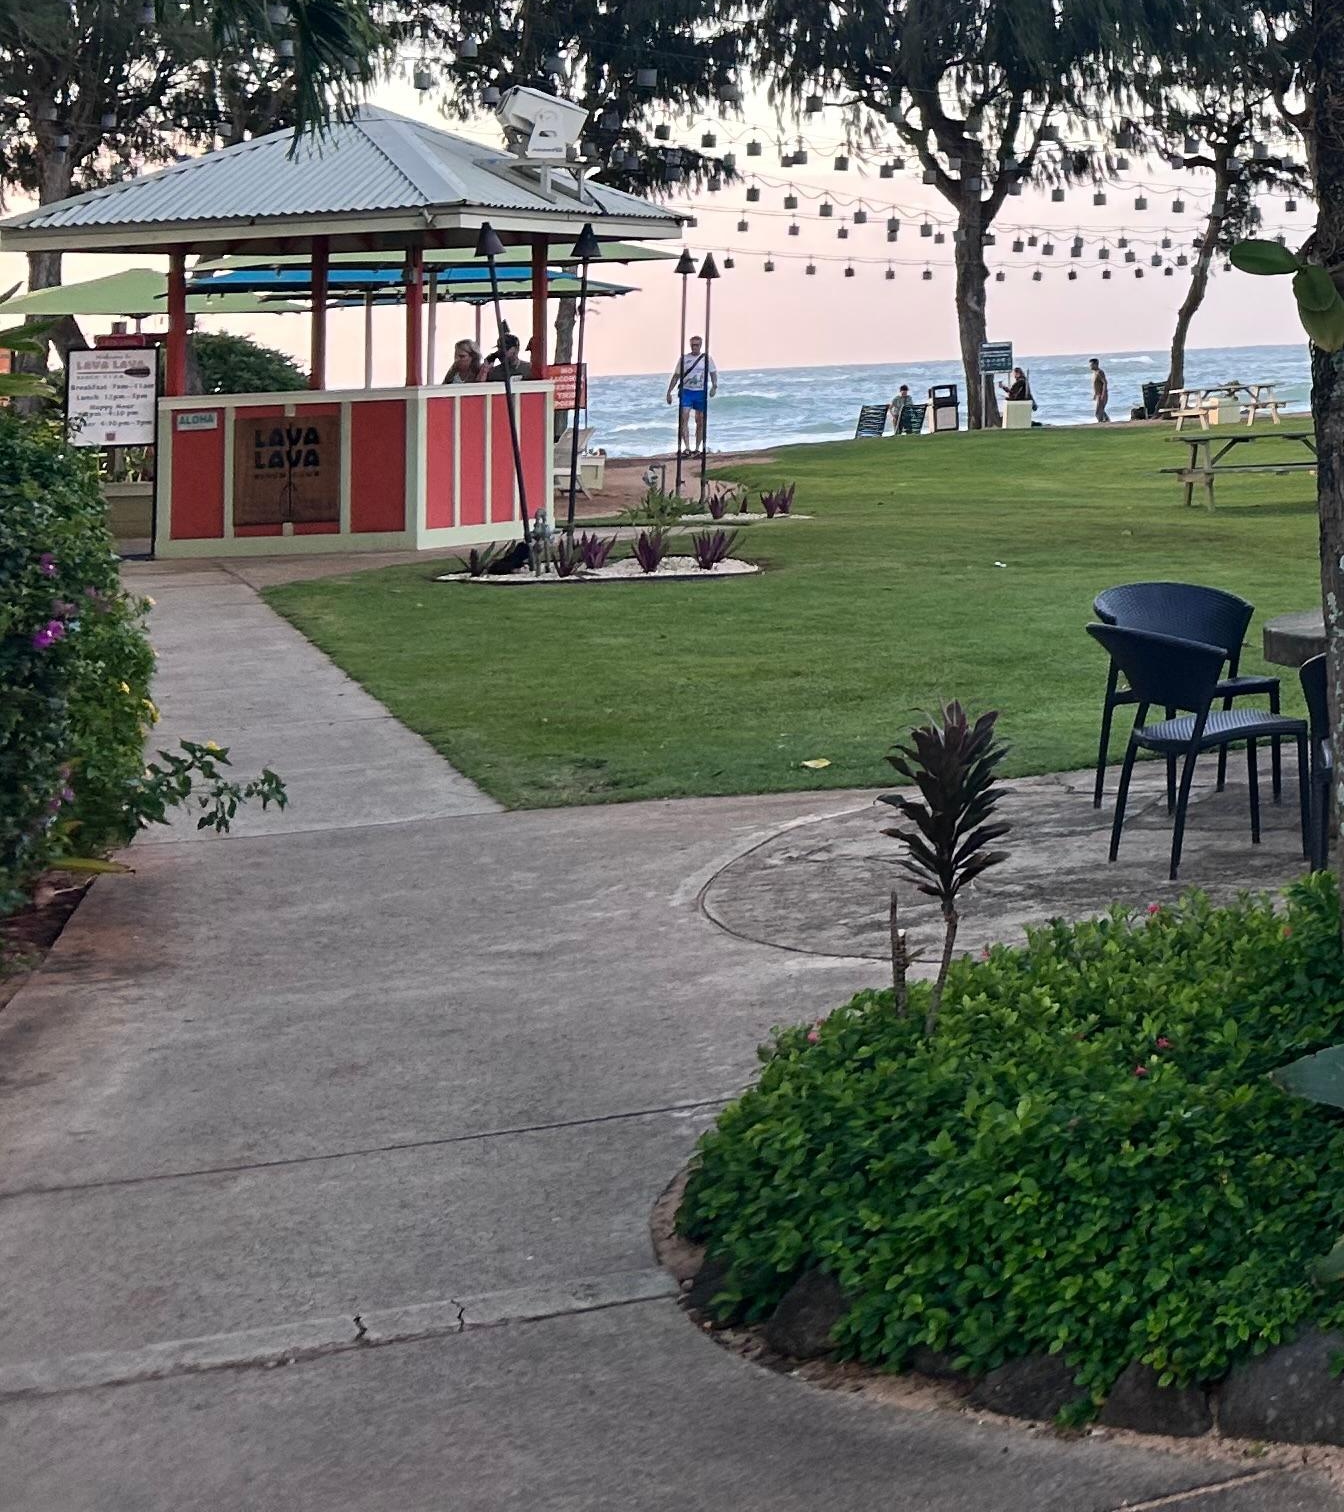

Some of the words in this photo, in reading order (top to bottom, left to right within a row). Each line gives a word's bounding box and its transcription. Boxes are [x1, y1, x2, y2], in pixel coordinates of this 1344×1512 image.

[179, 414, 214, 424] ALOHA
[254, 426, 320, 448] LAVA
[254, 448, 320, 469] LAVA
